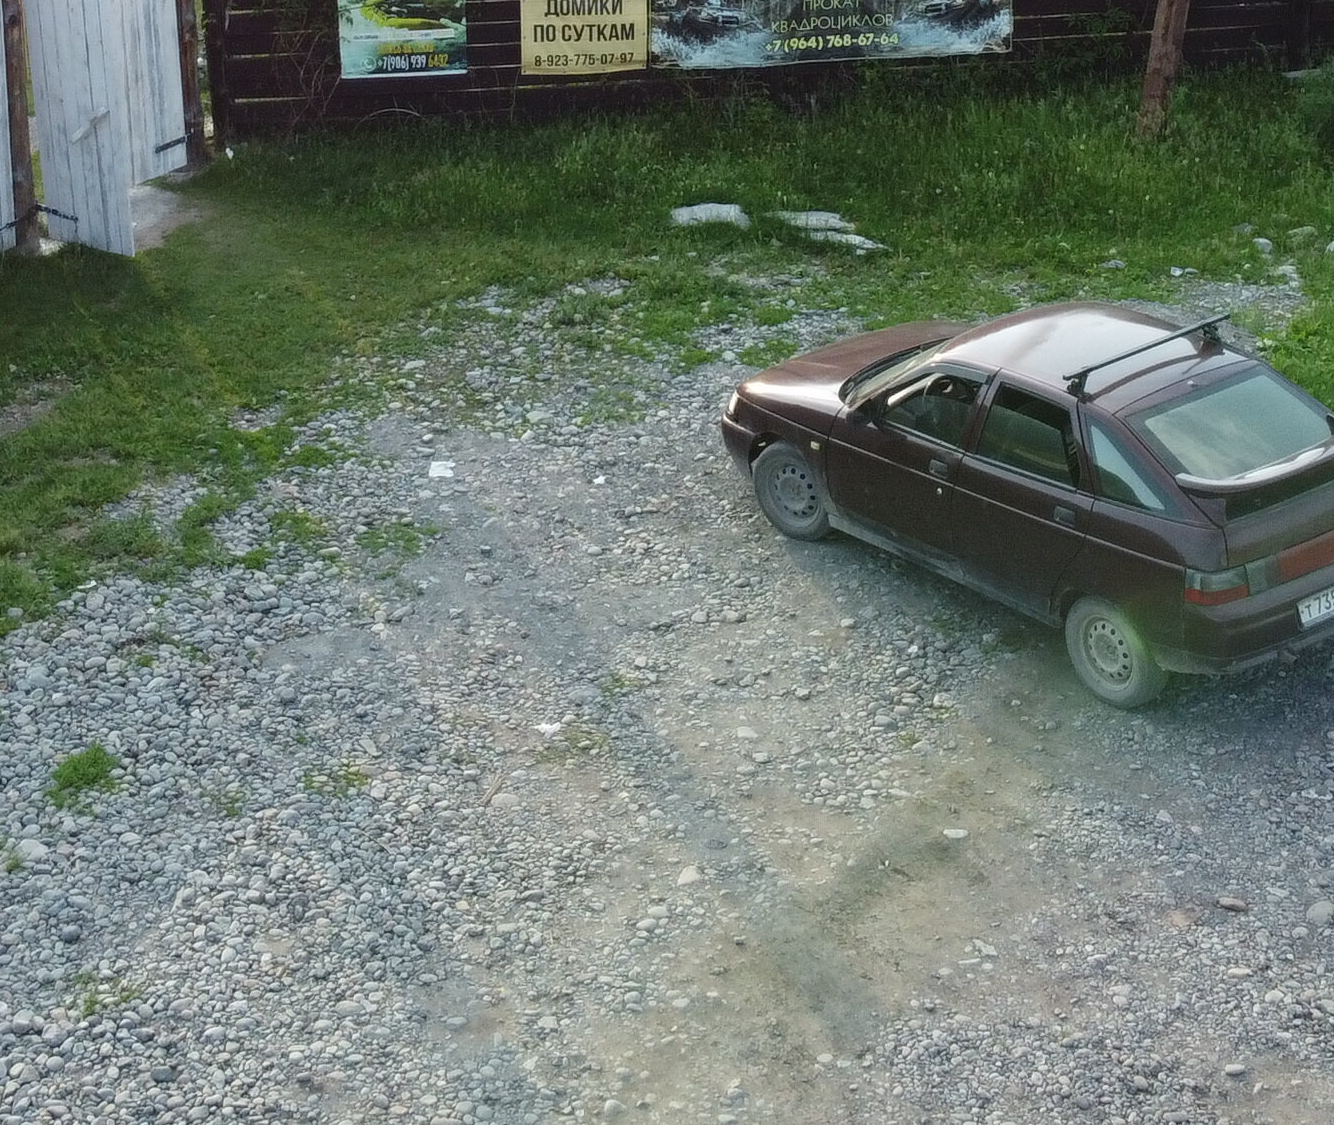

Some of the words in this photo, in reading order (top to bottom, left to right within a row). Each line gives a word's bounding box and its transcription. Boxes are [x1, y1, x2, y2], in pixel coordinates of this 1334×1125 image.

[533, 24, 556, 42] ПО
[561, 23, 635, 42] СУТКАМ
[771, 14, 894, 33] КВАДРОЦИКЛОВ
[766, 40, 782, 52] +7
[784, 36, 824, 53] (964)
[827, 33, 899, 48] 768-67-64
[534, 52, 635, 67] 8-923-775-07-97
